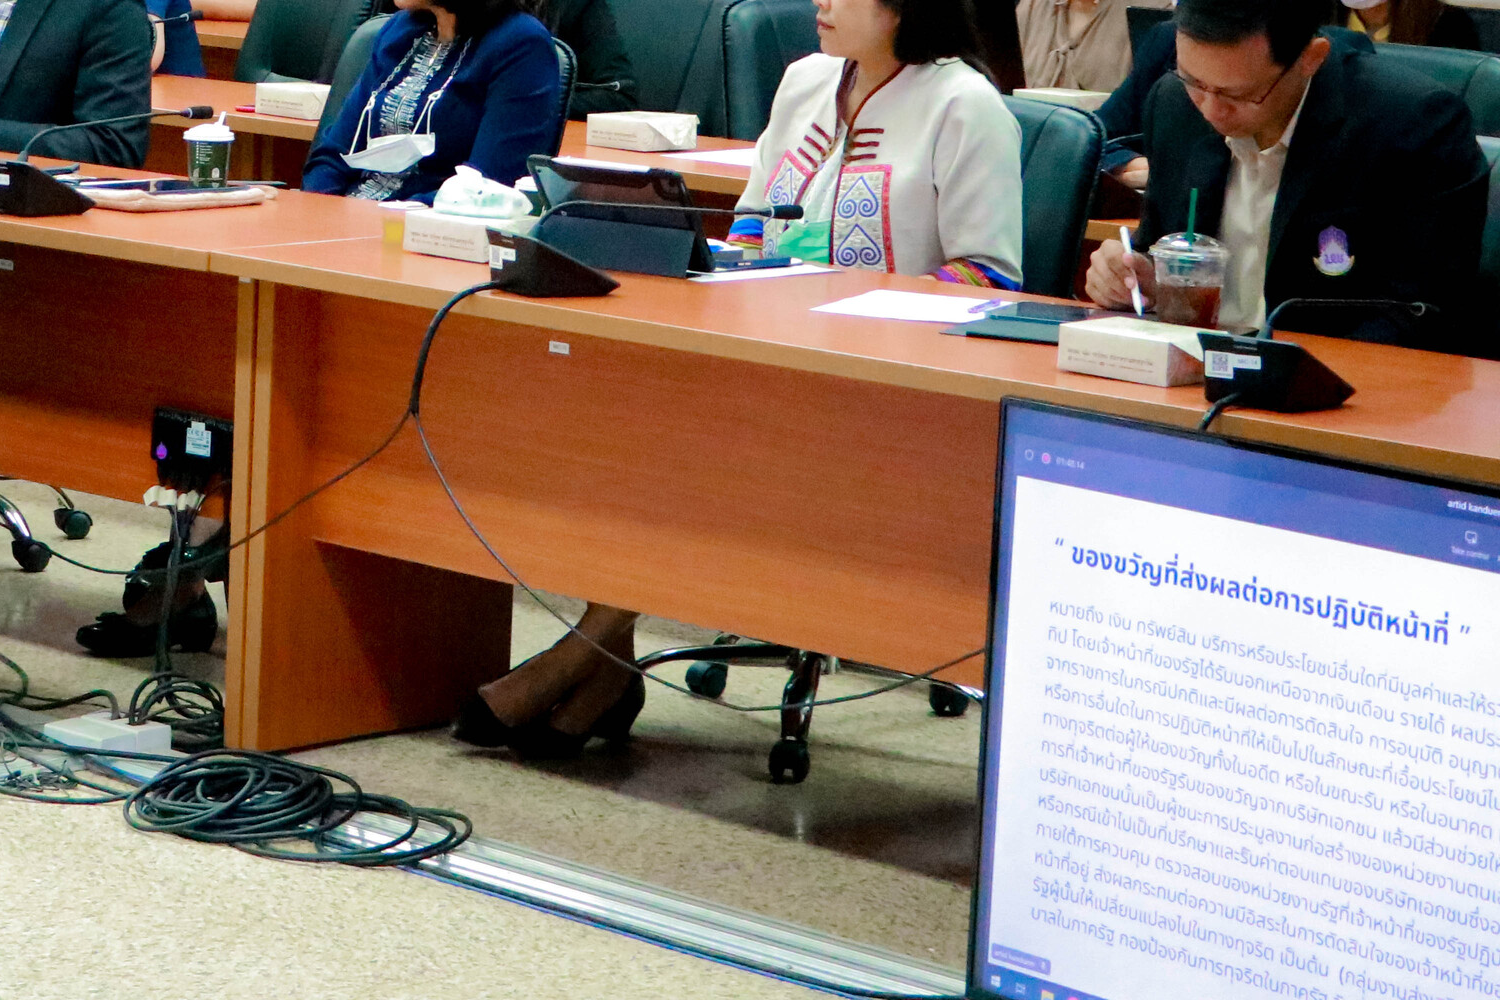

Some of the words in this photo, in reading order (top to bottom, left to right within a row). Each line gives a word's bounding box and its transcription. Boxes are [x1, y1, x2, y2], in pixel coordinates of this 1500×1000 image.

[1072, 545, 1450, 646] ของขวัญที่ส่งผลต่อการปฏิบัติหน้าที่
[1400, 710, 1445, 736] รายได้
[1369, 734, 1444, 766] การอนุมัติ
[1449, 753, 1500, 781] อนุญา
[1285, 773, 1384, 811] หรือในขณะรับ
[1390, 801, 1494, 840] หรือในอนาคต
[1280, 945, 1329, 978] เป็นต้น
